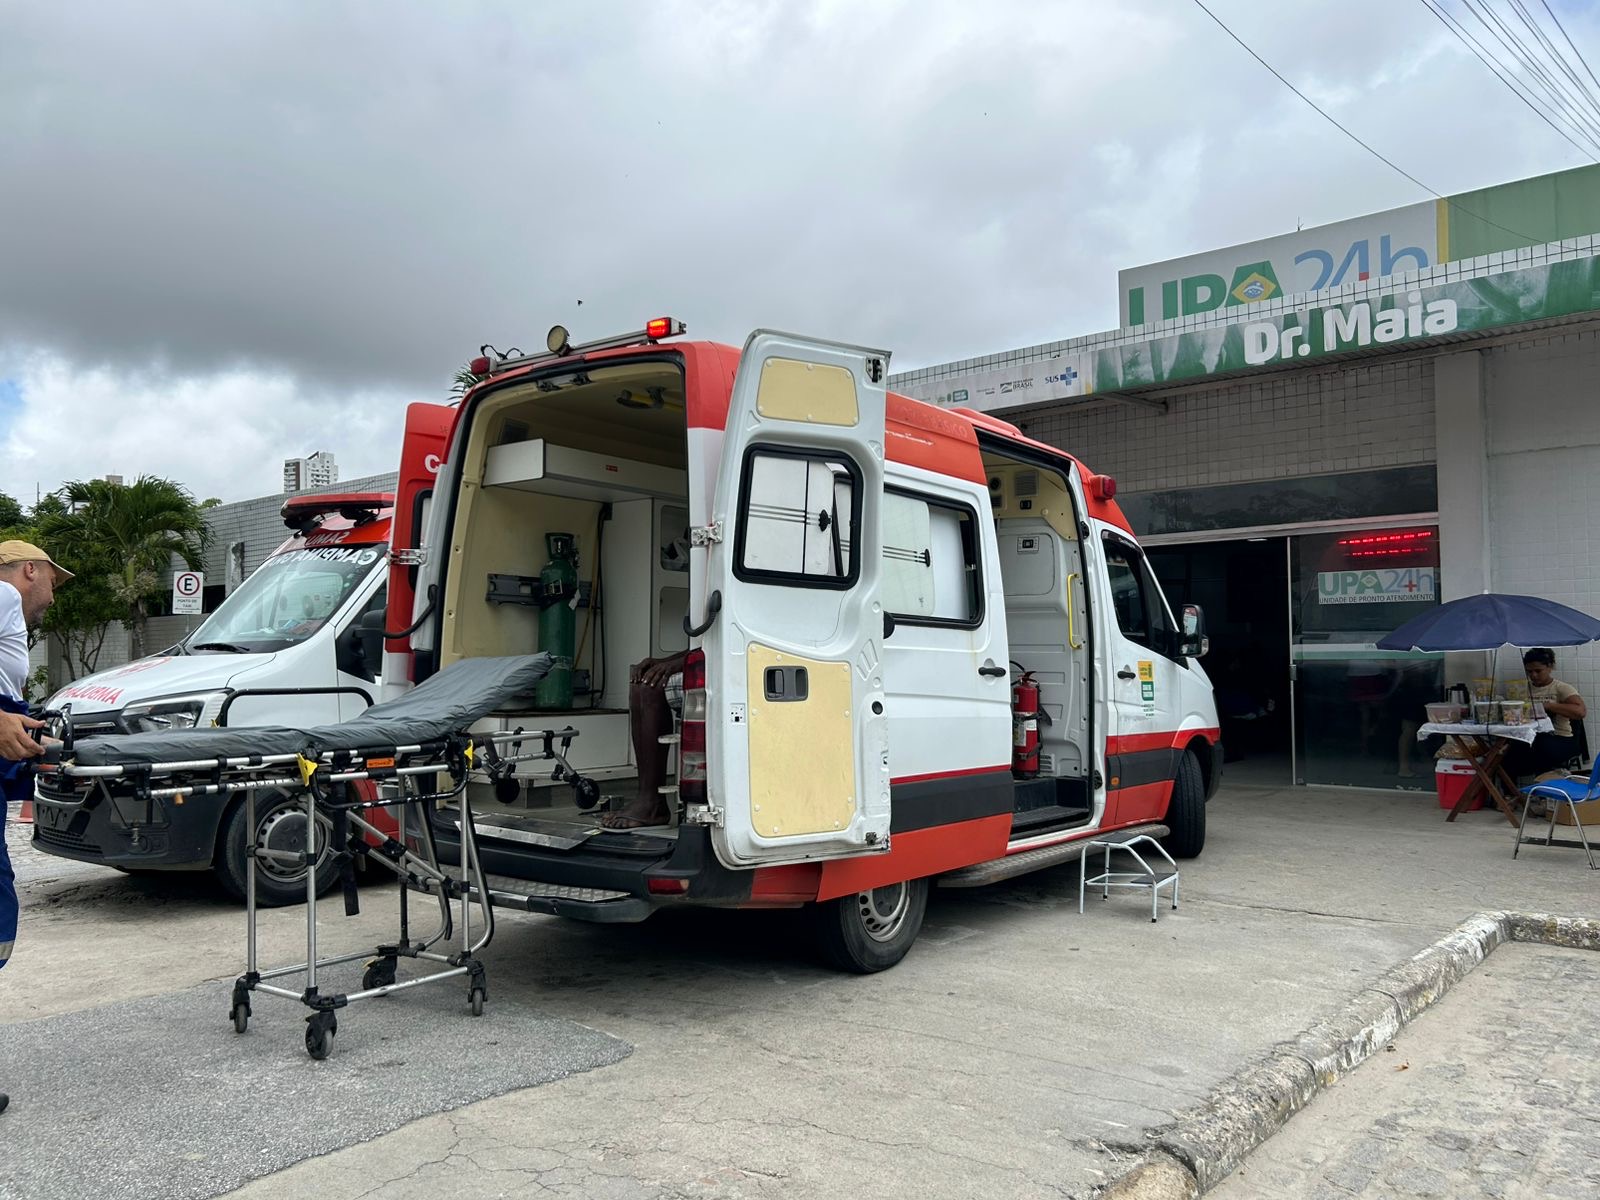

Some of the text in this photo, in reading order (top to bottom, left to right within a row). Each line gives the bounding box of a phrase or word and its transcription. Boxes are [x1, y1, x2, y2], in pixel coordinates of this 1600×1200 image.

[1129, 260, 1284, 326] UPA
[1243, 288, 1458, 365] Dr. Maia
[1045, 375, 1059, 384] SUS
[184, 578, 193, 591] E
[1320, 569, 1434, 595] UPA 24h
[1320, 593, 1434, 604] UNIDADE DE PRONTO ATENDIMENTO
